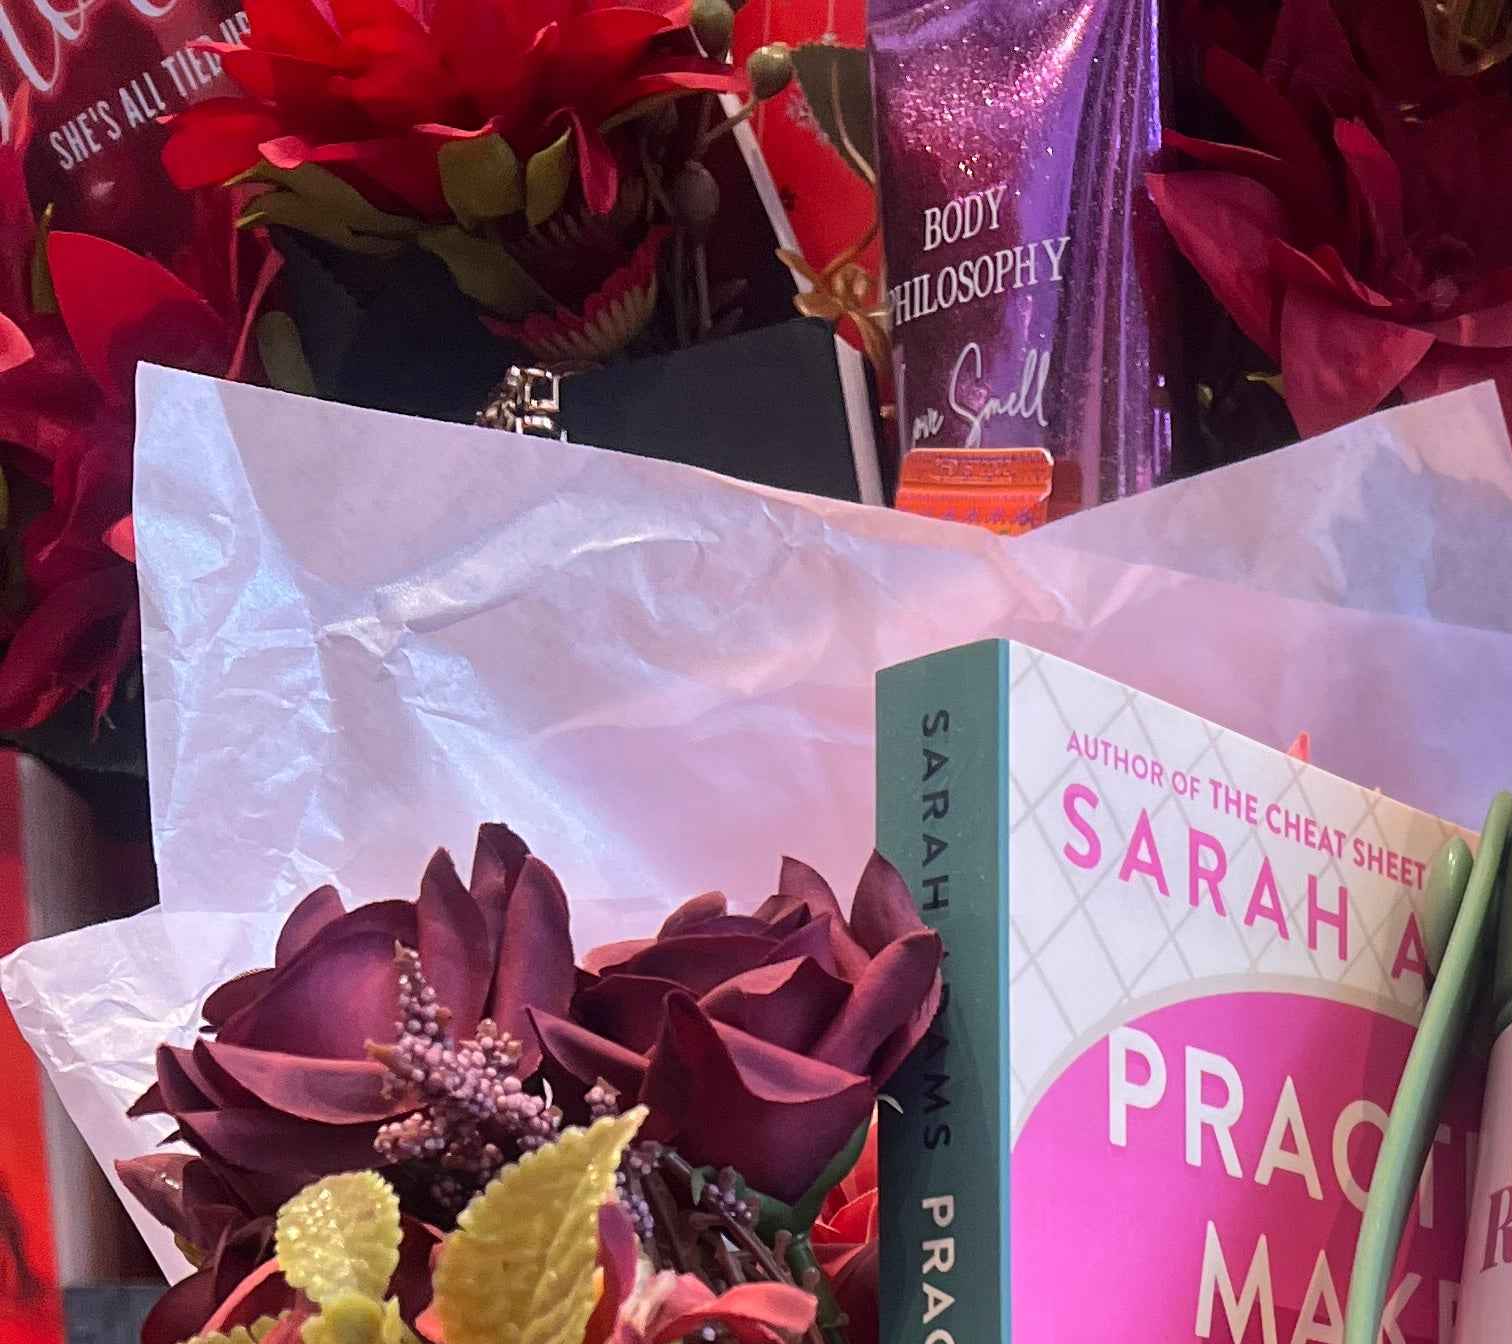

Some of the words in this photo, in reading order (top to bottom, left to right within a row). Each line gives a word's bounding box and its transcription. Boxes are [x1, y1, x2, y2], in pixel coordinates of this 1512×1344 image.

[50, 101, 122, 170] SHE'S
[119, 72, 166, 128] ALL
[889, 236, 1071, 326] HILOSOPHY
[923, 185, 1007, 251] BODY
[921, 708, 950, 912] SARAH
[1062, 783, 1349, 962] SARAH
[1066, 730, 1164, 788] AUTHOR
[1171, 770, 1200, 800] OF
[1208, 777, 1258, 825] THE
[1264, 802, 1345, 859] CHEAT
[1352, 838, 1427, 891] SHEET
